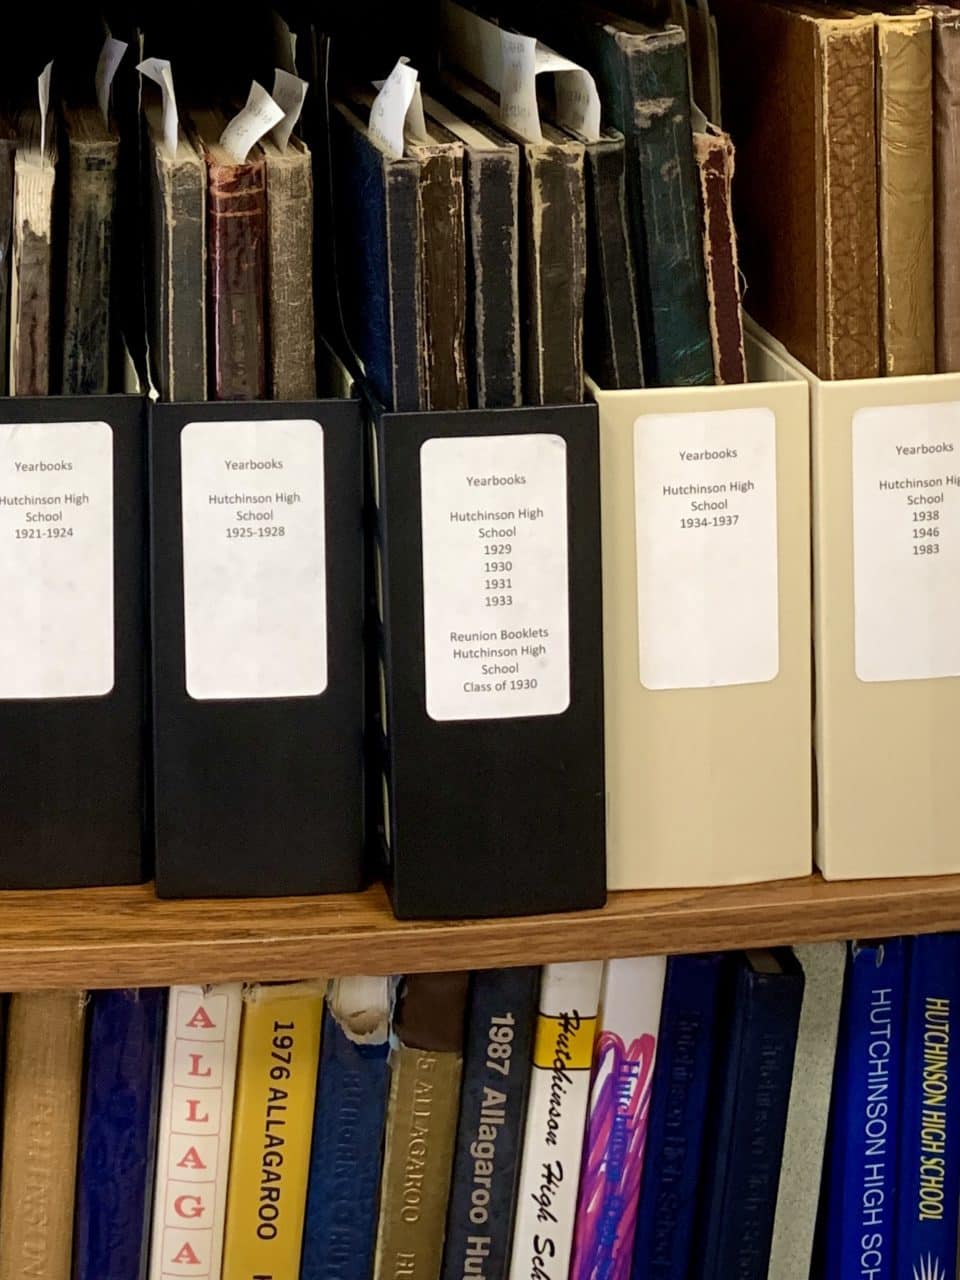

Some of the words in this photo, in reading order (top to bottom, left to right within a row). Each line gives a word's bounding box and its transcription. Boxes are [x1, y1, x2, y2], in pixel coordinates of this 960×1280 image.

[680, 448, 737, 461] Yearbooks
[467, 474, 526, 486] Yearbooks
[663, 485, 726, 495] Hutchinson
[730, 480, 754, 493] High
[691, 499, 727, 511] School
[450, 511, 515, 521] Hutchinson
[518, 508, 543, 520] High
[681, 515, 739, 528] 1934-1937
[479, 526, 516, 538] School
[485, 544, 512, 555] 1929
[486, 561, 512, 572] 1930
[486, 579, 512, 589] 1931
[486, 596, 512, 606] 1933
[450, 632, 497, 642] Reunion
[501, 628, 549, 640] Booklets
[454, 648, 517, 659] Hutchinson
[521, 644, 546, 657] High
[482, 663, 518, 675] School
[464, 682, 491, 692] Class
[495, 680, 506, 691] of
[511, 679, 537, 690] 1930
[270, 1021, 295, 1080] 1976
[485, 1012, 516, 1076] 1987
[920, 997, 950, 1106] HUTCHINSON
[543, 1009, 581, 1147] Hutchinson
[863, 989, 892, 1156] HUTCHINSON
[919, 1110, 947, 1153] HIGH
[468, 1087, 509, 1224] Allagaroo
[257, 1088, 288, 1240] ALLAGAROO
[534, 1160, 565, 1222] High
[861, 1163, 885, 1226] HIGH
[918, 1156, 944, 1221] SCHOOL
